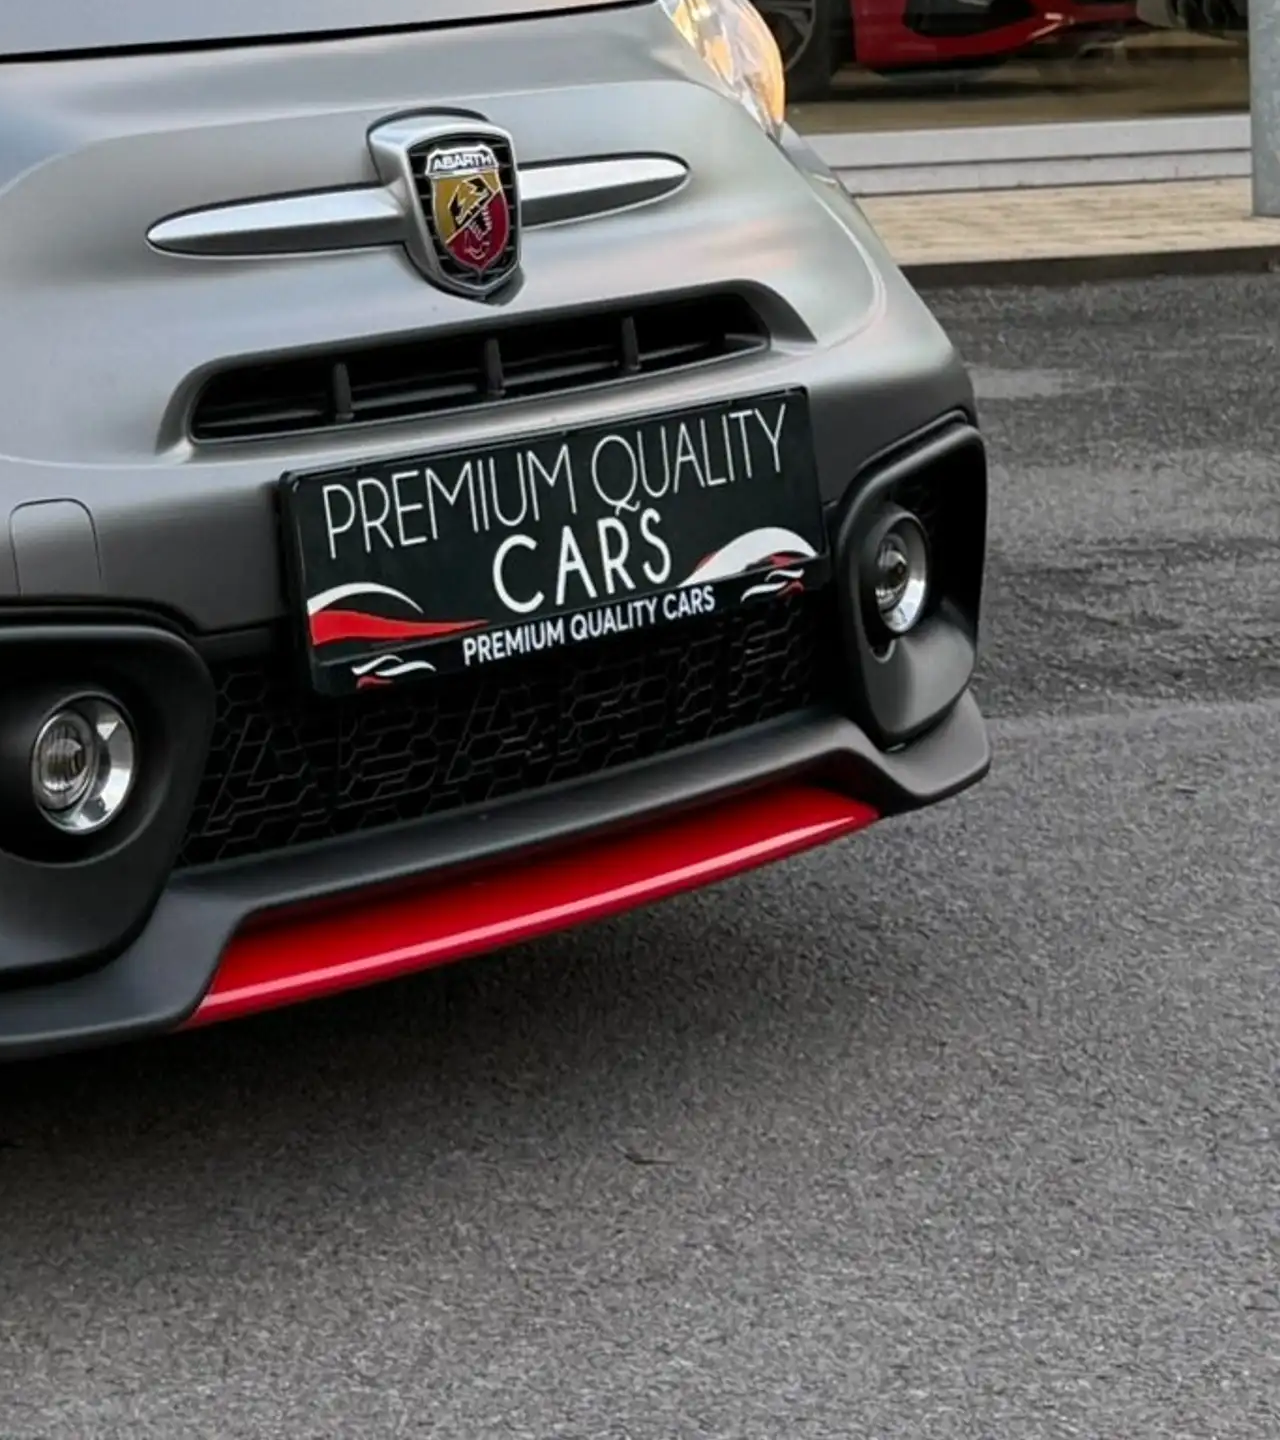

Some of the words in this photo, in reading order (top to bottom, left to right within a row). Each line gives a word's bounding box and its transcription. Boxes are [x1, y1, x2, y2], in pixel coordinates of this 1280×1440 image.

[433, 153, 493, 171] ABARTH
[322, 443, 577, 560] PREMIUM
[591, 404, 786, 517] QUALITY
[492, 507, 672, 614] CARS
[462, 617, 565, 666] PREMIUM
[570, 596, 659, 641] QUALITY
[661, 584, 716, 620] CARS
